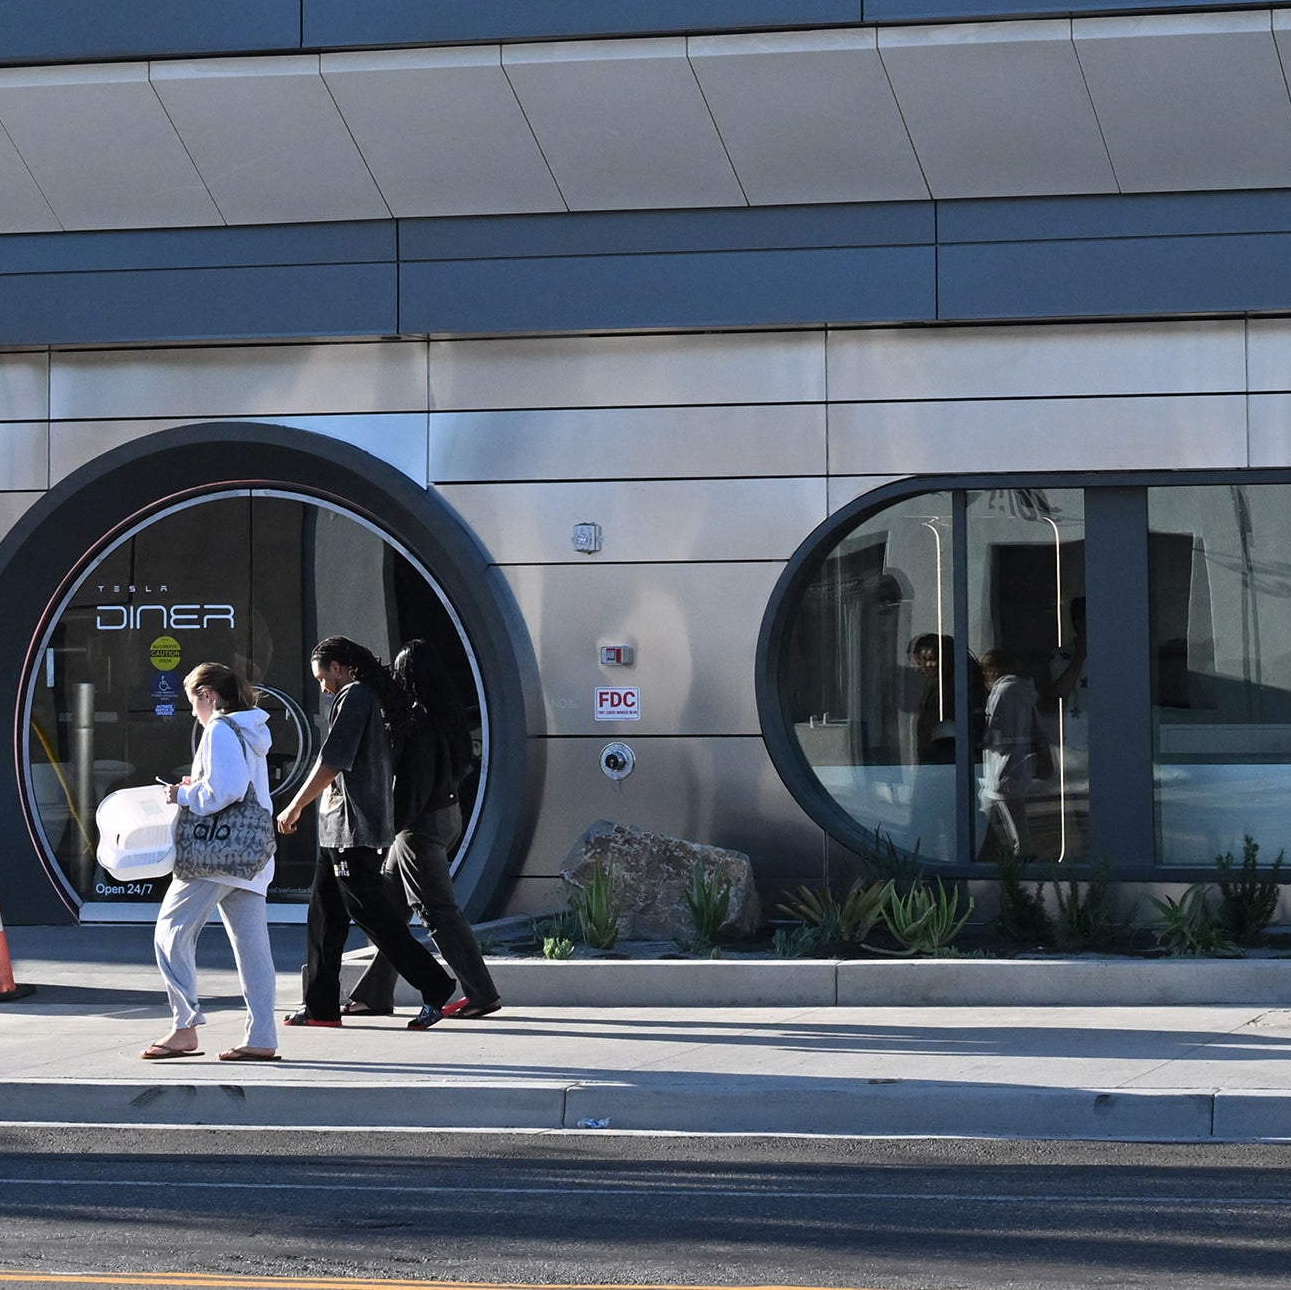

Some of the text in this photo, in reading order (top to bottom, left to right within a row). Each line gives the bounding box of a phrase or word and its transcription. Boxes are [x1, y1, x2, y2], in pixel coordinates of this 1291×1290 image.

[97, 585, 168, 593] TESLA
[96, 604, 235, 630] DINER
[598, 691, 636, 708] FDC
[193, 815, 231, 842] alo
[95, 883, 153, 896] Open 24/7
